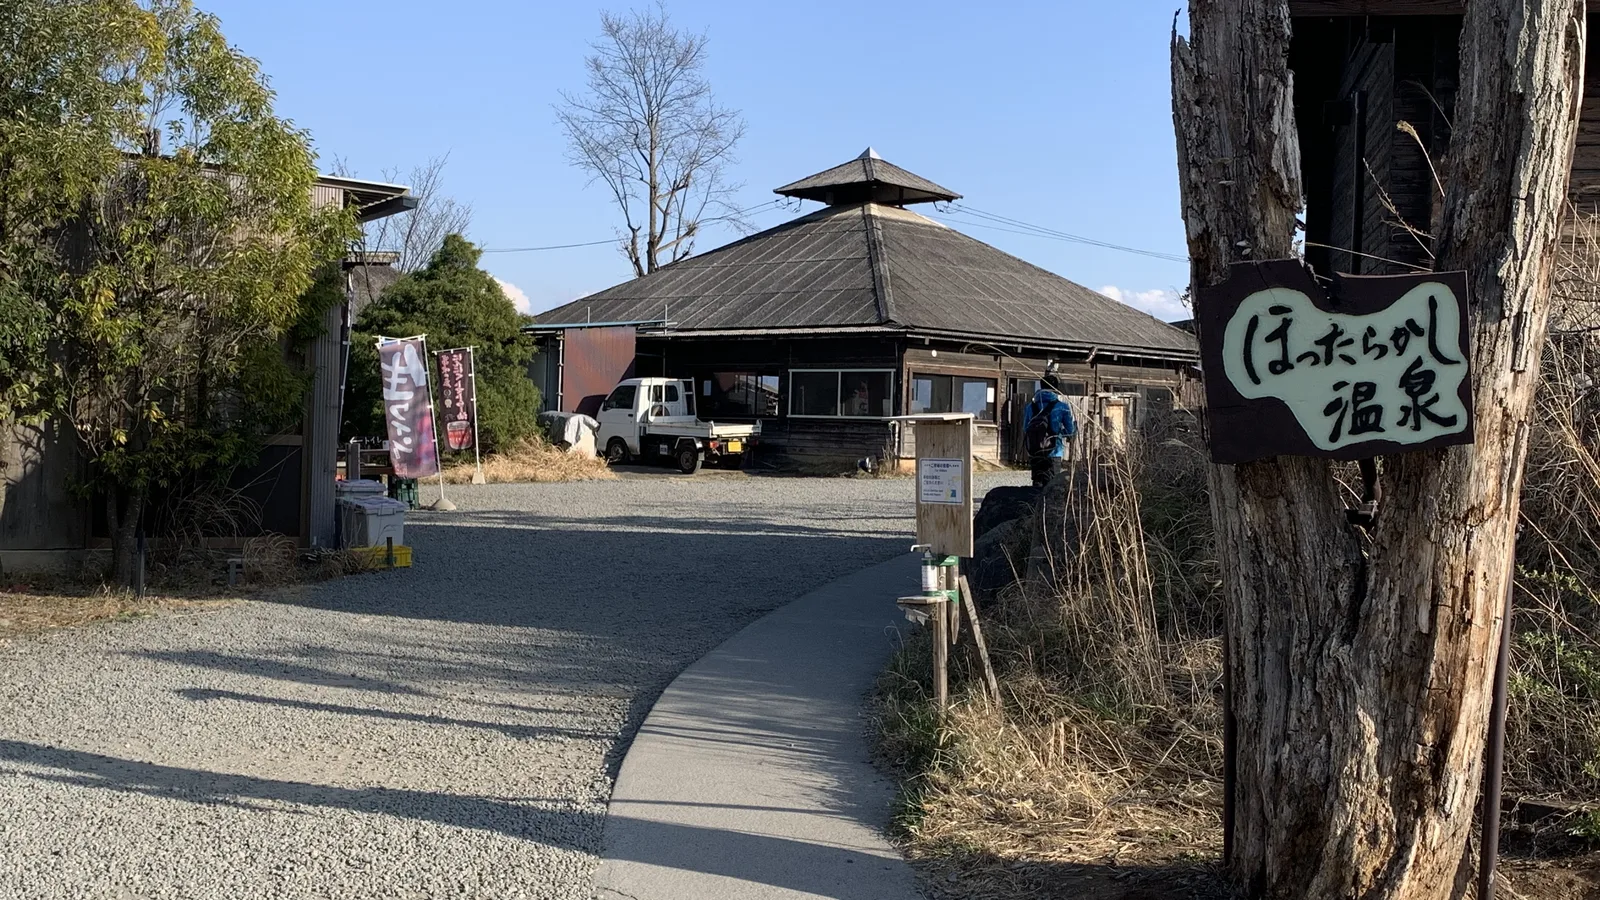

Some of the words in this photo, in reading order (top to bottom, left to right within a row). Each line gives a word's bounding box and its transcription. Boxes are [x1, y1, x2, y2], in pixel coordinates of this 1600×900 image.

[1243, 295, 1461, 385] ほったらかし
[1323, 355, 1457, 443] 温泉
